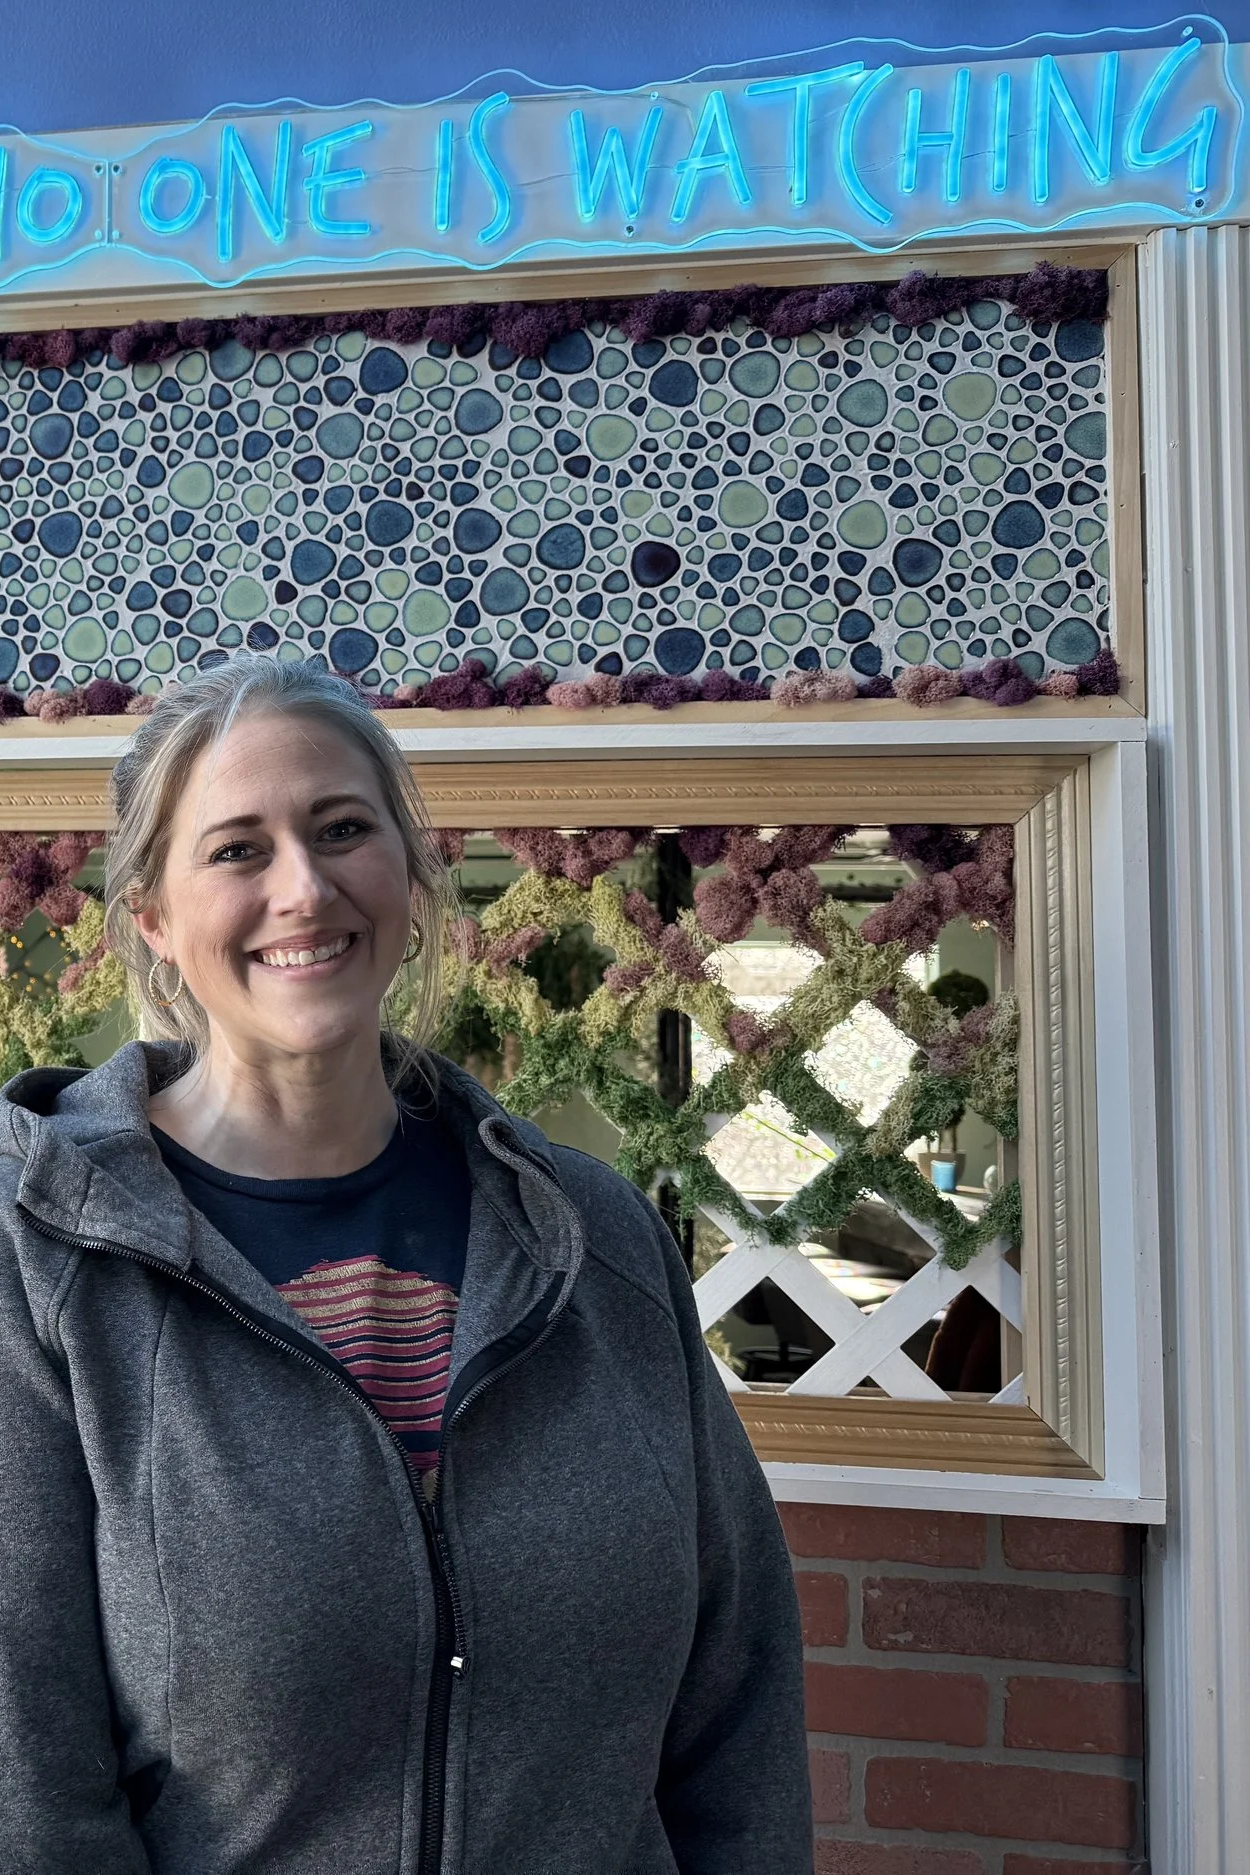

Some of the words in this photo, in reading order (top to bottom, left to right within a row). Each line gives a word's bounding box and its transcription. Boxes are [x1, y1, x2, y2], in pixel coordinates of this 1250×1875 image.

[139, 119, 374, 262] ONE
[436, 91, 511, 245] IS
[569, 37, 1218, 225] WATCHING
